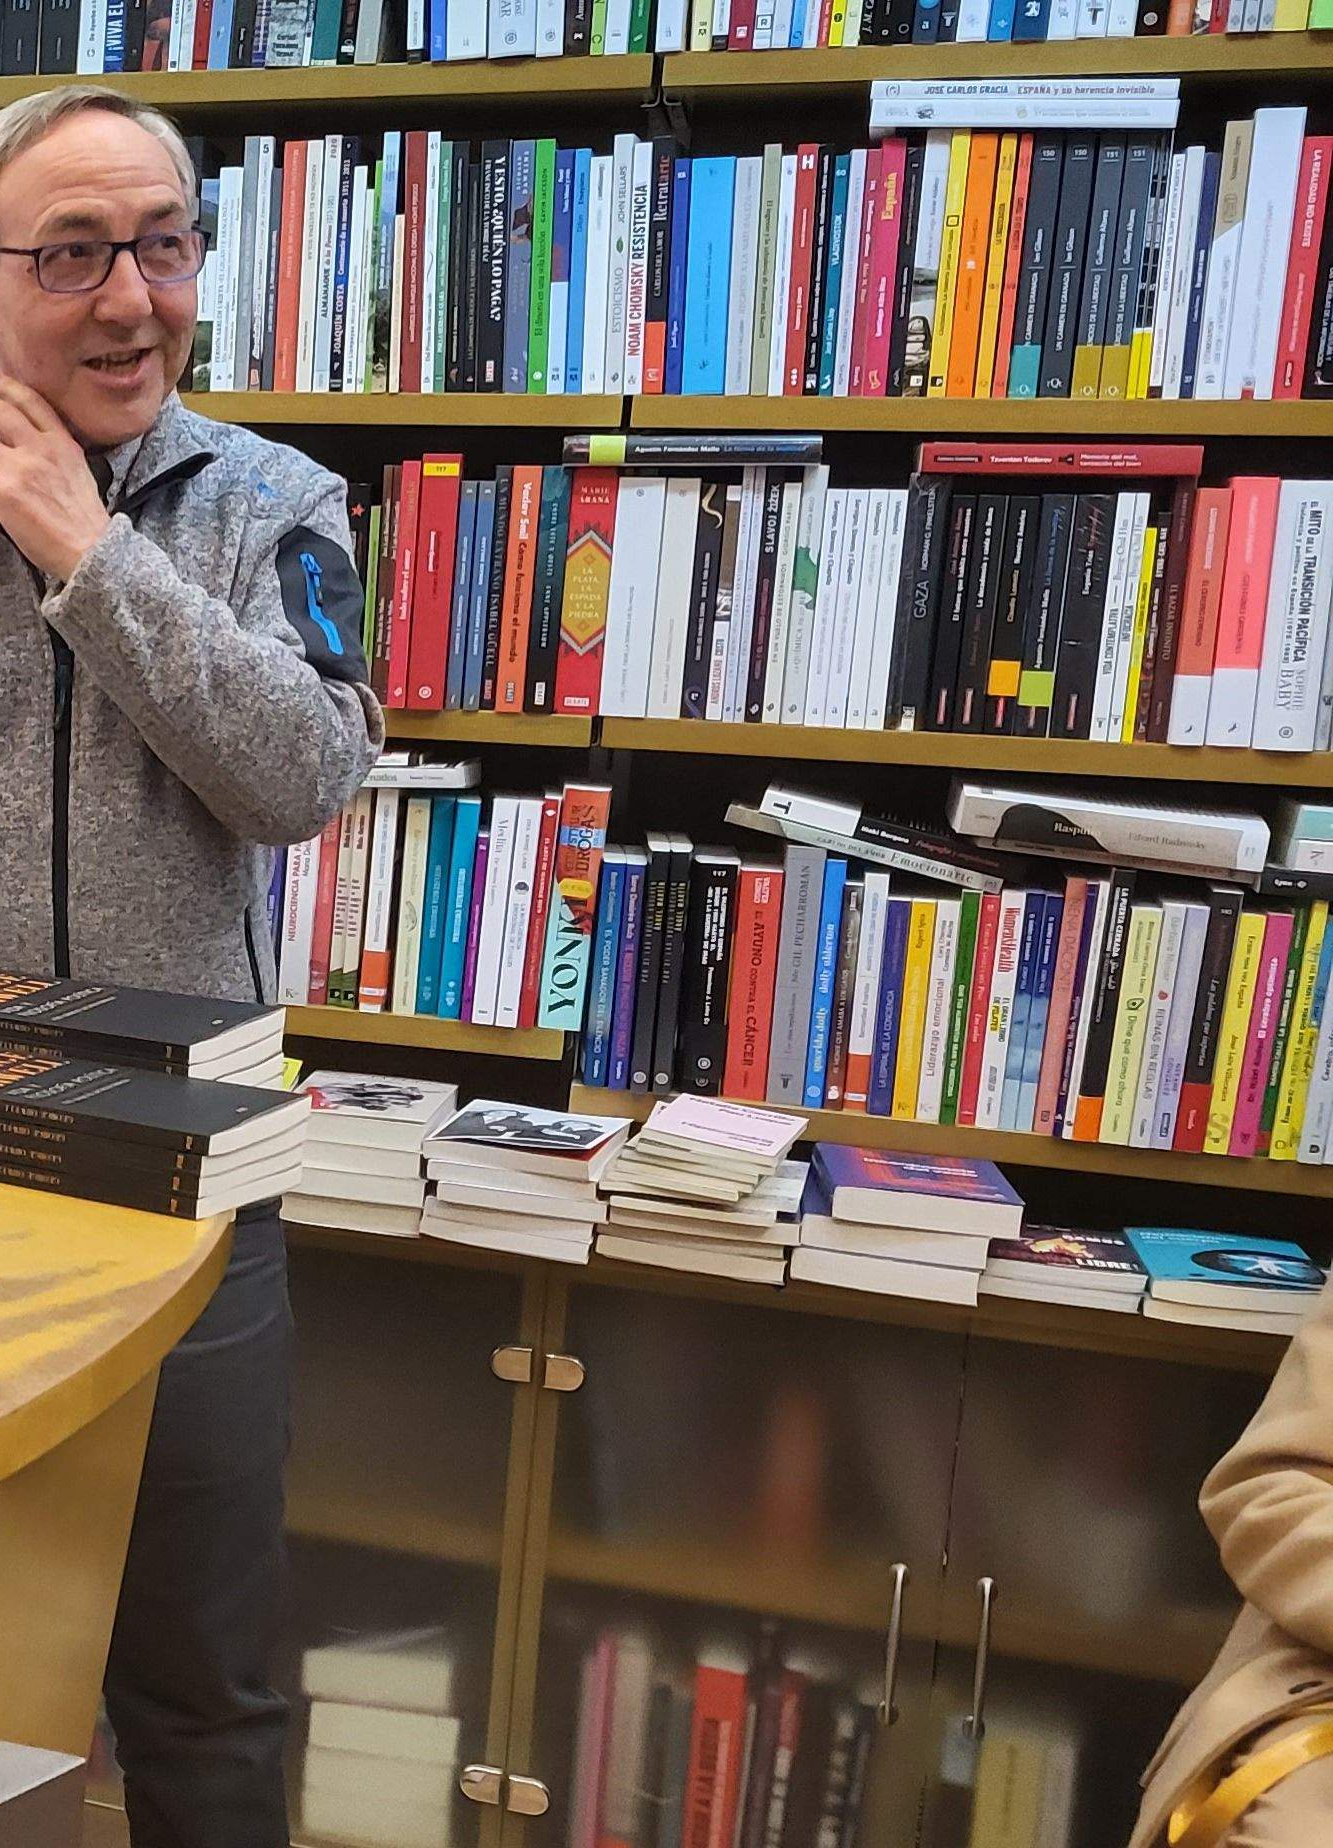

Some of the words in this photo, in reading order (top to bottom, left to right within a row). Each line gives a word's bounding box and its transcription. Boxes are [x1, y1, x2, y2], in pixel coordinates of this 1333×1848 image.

[946, 85, 978, 95] CARLOS
[979, 85, 1009, 95] GRACIA
[1017, 84, 1052, 96] ESPAÑA
[1075, 85, 1114, 95] herencia
[1116, 84, 1156, 95] invisible
[653, 155, 669, 221] Retratarte
[881, 172, 898, 220] España
[1309, 163, 1322, 203] REALIDAD
[631, 185, 647, 259] RESISTENCIA
[1306, 205, 1315, 216] NO
[612, 267, 623, 333] ESTOICISMO
[618, 166, 627, 199] SELLARS
[335, 284, 345, 312] COSTA
[629, 263, 644, 319] CHOMSKY
[1028, 272, 1038, 303] GRANADA
[1060, 272, 1070, 303] GRANADA
[1091, 274, 1101, 303] LIBERTAD
[1118, 274, 1129, 303] LIBERTAD
[1027, 304, 1036, 313] EN
[1059, 304, 1067, 313] EN
[333, 314, 343, 354] JOAQUÍN
[627, 323, 641, 356] NOAM
[1025, 314, 1035, 340] CARMEN
[1056, 314, 1066, 339] CARMEN
[521, 482, 532, 516] Vaclav
[496, 496, 508, 537] MUNDO
[518, 518, 530, 540] Smil
[1307, 510, 1323, 535] MITO
[765, 515, 777, 553] SLAVOJ
[921, 538, 930, 570] NORMAN
[512, 573, 524, 616] funciona
[914, 580, 929, 618] GAZA
[1298, 555, 1317, 615] TRANSICIÓN
[489, 593, 500, 631] ISABEL
[513, 618, 521, 626] el
[776, 607, 783, 617] DE
[509, 629, 520, 663] mundo
[774, 619, 782, 640] VUELO
[1292, 618, 1312, 663] PACÍFICA
[1276, 669, 1293, 709] BABY
[292, 855, 301, 876] PARA
[288, 879, 300, 941] NEUROCIENCIA
[794, 865, 811, 947] PECHARROMÁN
[1120, 888, 1129, 898] LA
[1114, 900, 1127, 924] PUERTA
[751, 922, 764, 966] AYUNO
[792, 950, 803, 967] GIL
[748, 968, 758, 1002] CONTRA
[929, 978, 944, 1027] emocional
[1259, 998, 1272, 1029] cerebro
[742, 1017, 759, 1066] CÁNCER
[1126, 1015, 1138, 1037] Dime
[926, 1029, 939, 1076] Liderazgo
[1142, 1061, 1158, 1099] REGLAS
